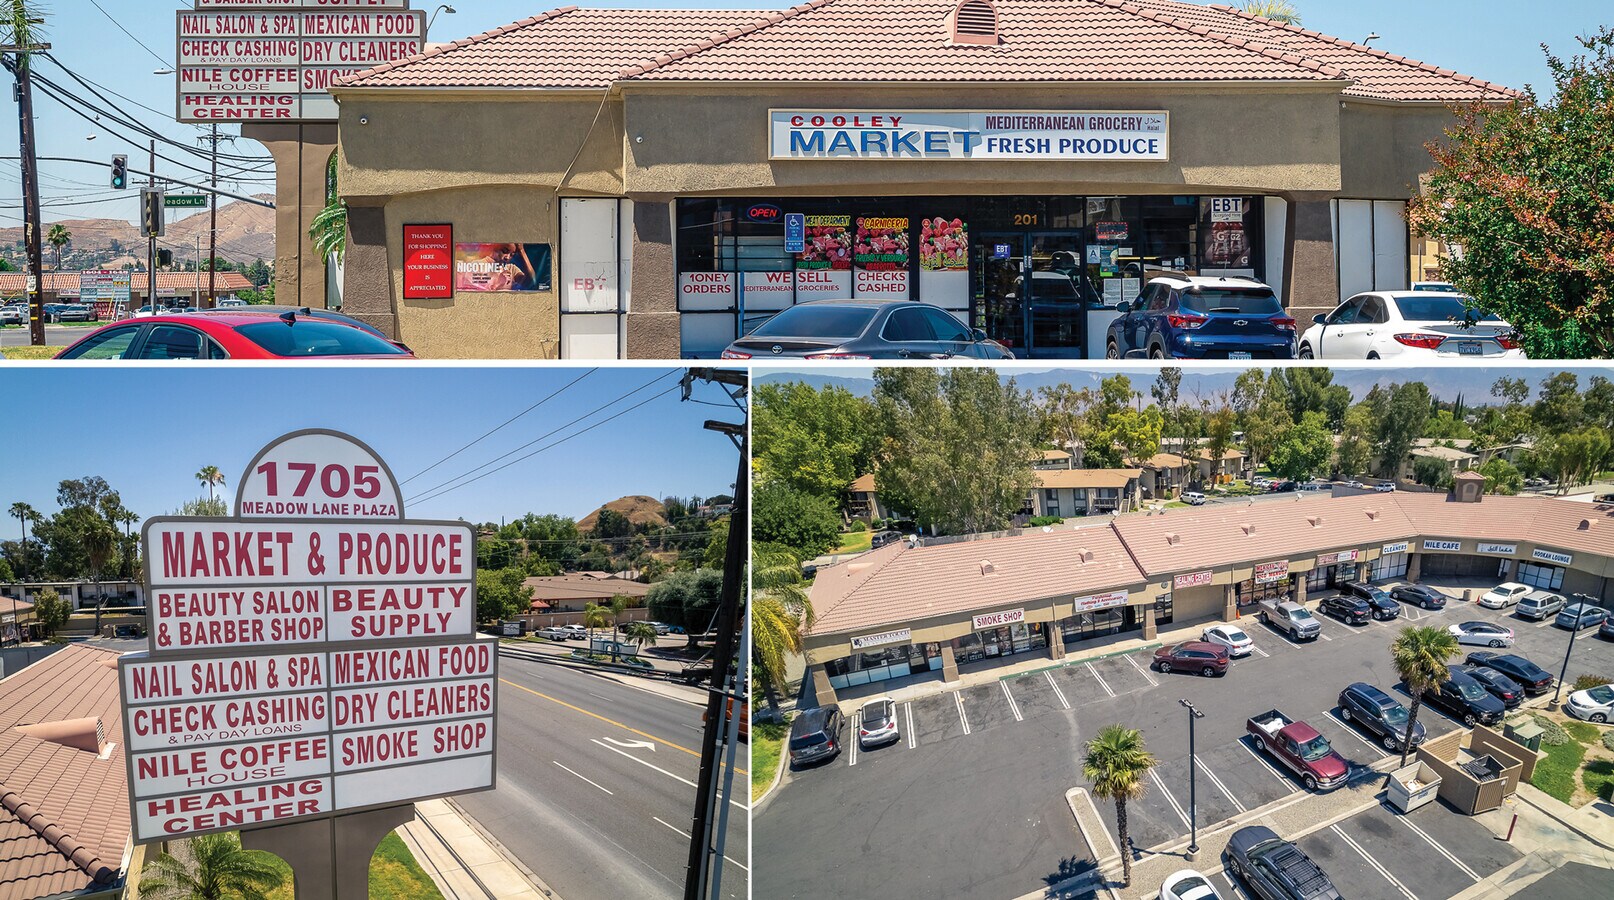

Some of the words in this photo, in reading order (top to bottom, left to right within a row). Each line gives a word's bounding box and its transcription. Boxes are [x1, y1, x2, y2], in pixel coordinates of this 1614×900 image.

[183, 15, 210, 34] NAIL
[216, 15, 254, 34] SALON
[260, 15, 268, 34] &
[274, 15, 296, 34] SPA
[305, 14, 370, 34] MEXICAN
[376, 14, 414, 34] FOOD
[182, 40, 229, 56] CHECK
[234, 40, 297, 56] CASHING
[303, 42, 332, 62] DRY
[340, 41, 417, 62] CLEANERS
[182, 68, 222, 82] NILE
[229, 68, 297, 82] COFFEE
[185, 96, 294, 106] HEALING
[193, 108, 292, 118] CENTER
[790, 116, 902, 127] COOLEY
[986, 116, 1084, 130] MEDITERRANEAN
[1089, 116, 1142, 130] GROCERY
[790, 131, 980, 155] MARKET
[987, 138, 1050, 154] FRESH
[1059, 138, 1158, 154] PRODUCE
[750, 208, 778, 217] OPEN
[1213, 199, 1241, 212] EBT
[864, 218, 908, 229] CARNICERIA
[1014, 214, 1038, 226] 201
[1216, 232, 1225, 240] G
[457, 262, 500, 273] NICOTINE
[766, 272, 791, 283] WE
[798, 272, 832, 282] SELL
[858, 272, 906, 281] CHECKS
[683, 285, 731, 293] ORDERS
[858, 284, 906, 292] CASHED
[258, 462, 380, 499] 1705
[242, 501, 308, 515] MEADOW
[313, 503, 348, 516] LANE
[354, 504, 396, 516] PLAZA
[162, 532, 293, 578] MARKET
[308, 532, 326, 576] &
[338, 532, 462, 575] PRODUCE
[1384, 544, 1407, 553] CLEANERS
[1534, 550, 1551, 559] HOOKAH
[1552, 554, 1570, 564] LOUNGE
[1175, 574, 1194, 584] HEALING
[159, 592, 244, 618] BEAUTY
[253, 590, 318, 614] SALON
[333, 586, 467, 612] BEAUTY
[351, 612, 452, 638] SUPPLY
[977, 615, 1002, 626] SMOKE
[1004, 612, 1022, 622] SHOP
[158, 622, 172, 647] &
[180, 619, 263, 646] BARBER
[271, 616, 323, 642] SHOP
[336, 649, 429, 685] MEXICAN
[439, 644, 489, 676] FOOD
[132, 665, 182, 699] NAIL
[191, 660, 258, 694] SALON
[266, 658, 279, 689] &
[288, 656, 322, 687] SPA
[335, 692, 379, 726] DRY
[388, 683, 490, 720] CLEANERS
[134, 704, 216, 736] CHECK
[226, 695, 325, 728] CASHING
[168, 735, 179, 744] &
[184, 732, 214, 743] PAY
[219, 729, 249, 740] DAY
[254, 724, 302, 736] LOANS
[342, 730, 418, 766] SMOKE
[433, 722, 486, 754] SHOP
[138, 752, 207, 780] NILE
[220, 738, 327, 769] COFFEE
[187, 766, 286, 787] HOUSE
[148, 780, 323, 816] HEALING
[163, 800, 320, 833] CENTER
